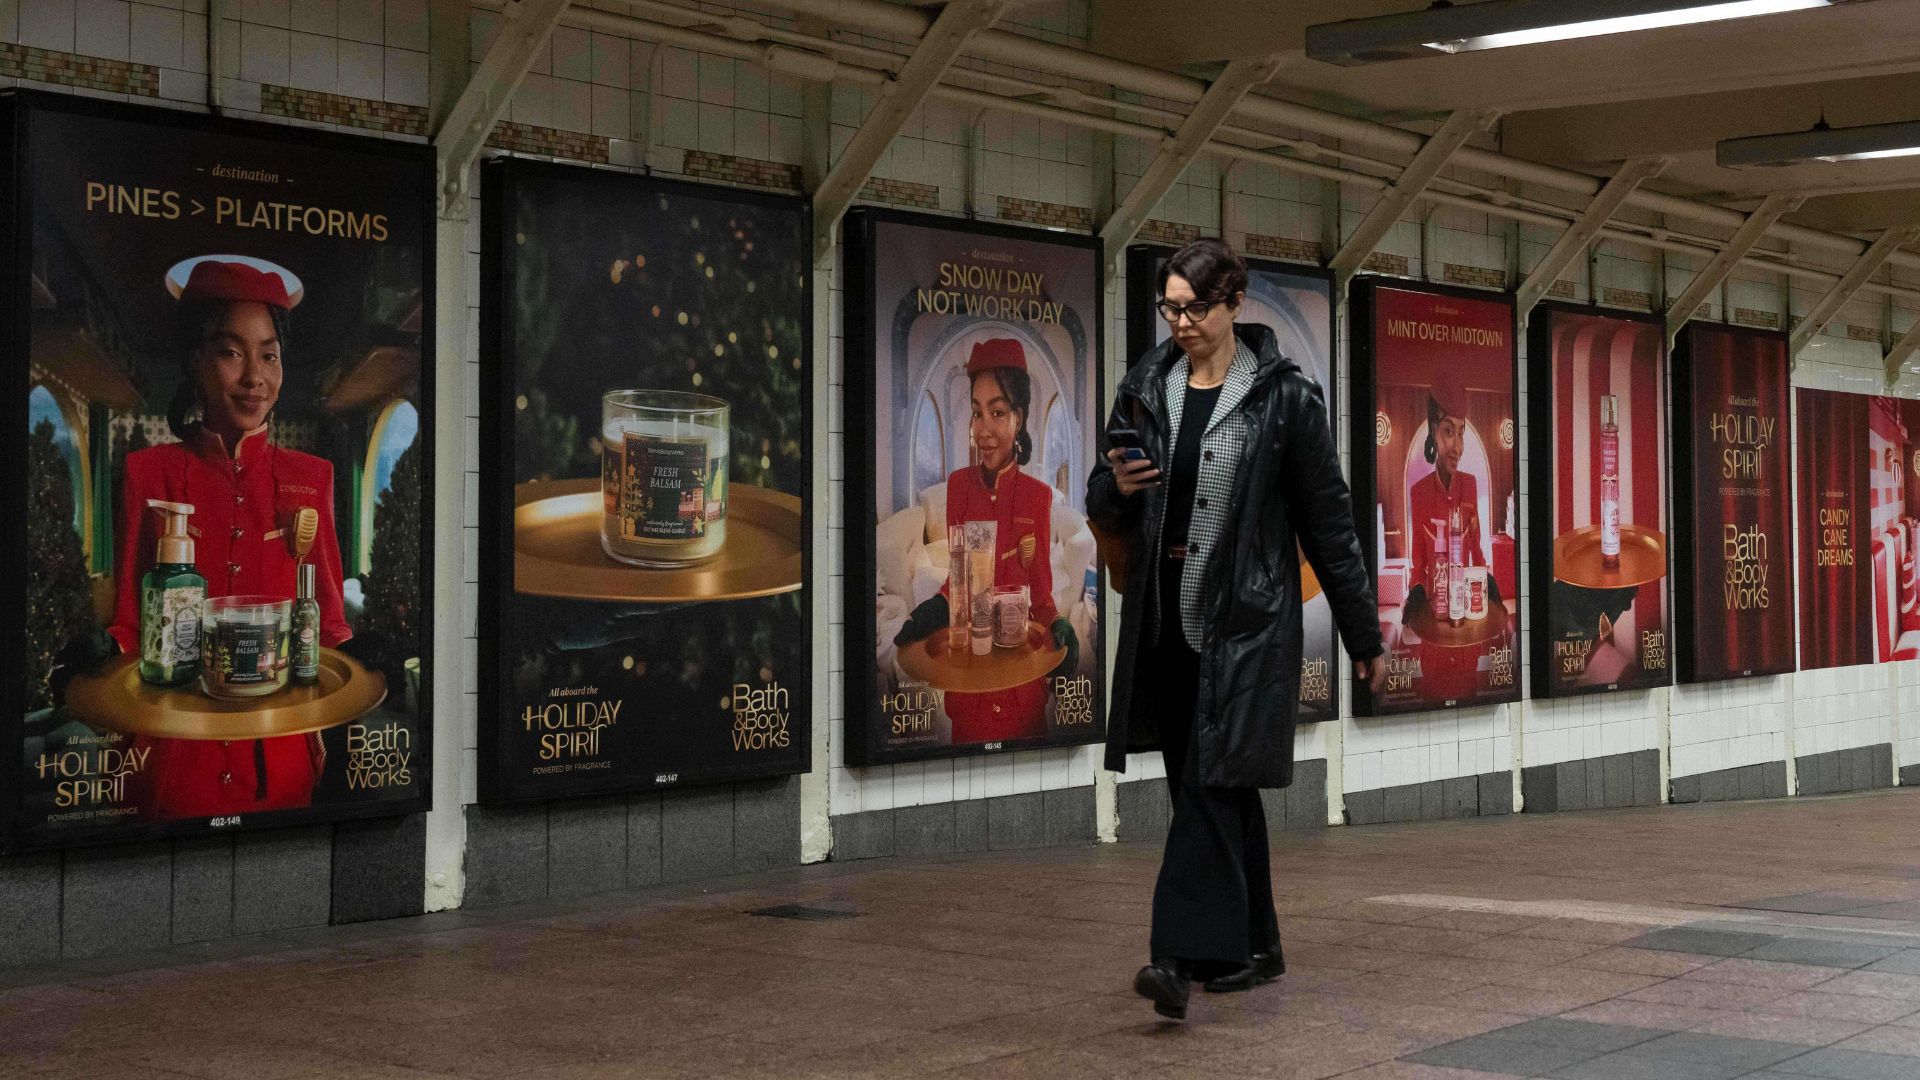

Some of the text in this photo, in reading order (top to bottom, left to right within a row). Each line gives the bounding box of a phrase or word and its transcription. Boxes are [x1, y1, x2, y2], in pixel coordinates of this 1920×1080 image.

[212, 163, 279, 184] destination
[86, 181, 181, 220] PINES
[216, 196, 388, 242] PLATFORMS
[940, 262, 1043, 296] SNOW DAY
[917, 288, 1064, 325] NOT WORK DAY
[1387, 319, 1504, 348] MINT OVER MIDTOWN
[1709, 412, 1775, 446] HOLIDAY
[653, 466, 679, 478] FRESH
[1722, 443, 1766, 480] SPIRIT
[650, 478, 682, 489] BALSAM
[1819, 508, 1850, 526] CANDY
[1723, 523, 1768, 560] Bath
[1823, 529, 1848, 546] CANE
[1817, 549, 1854, 567] DREAMS
[1725, 557, 1768, 588] &Body
[1723, 581, 1769, 610] Works
[1558, 639, 1593, 656] HOLIDAY
[1642, 629, 1665, 648] Bath
[1489, 645, 1513, 664] Bath
[1563, 653, 1587, 673] SPIRIT
[1642, 657, 1666, 671] Works
[1302, 656, 1328, 676] Bath
[1055, 674, 1092, 698] Bath
[1301, 674, 1328, 689] Body
[1387, 670, 1414, 691] SPIRIT
[1488, 673, 1513, 686] Works
[549, 685, 599, 696] All aboard the
[732, 681, 789, 713] Bath
[880, 689, 944, 713] HOLIDAY
[1056, 694, 1092, 713] &Body
[521, 699, 623, 732] HOLIDAY
[733, 708, 790, 732] &Body
[891, 708, 935, 734] SPIRIT
[1055, 708, 1093, 726] Works
[66, 732, 124, 745] All aboard the
[347, 721, 410, 753] Bath
[539, 723, 608, 760] SPIRIT
[732, 726, 790, 752] Works
[34, 746, 152, 779] HOLIDAY
[348, 748, 411, 770] &Body
[532, 760, 611, 775] POWERED BY FRAGRANCE
[346, 765, 411, 790] Works
[55, 770, 133, 807] SPIRIT
[47, 807, 140, 822] POWERED BY FRAGRANCE
[210, 816, 241, 827] 402-149
